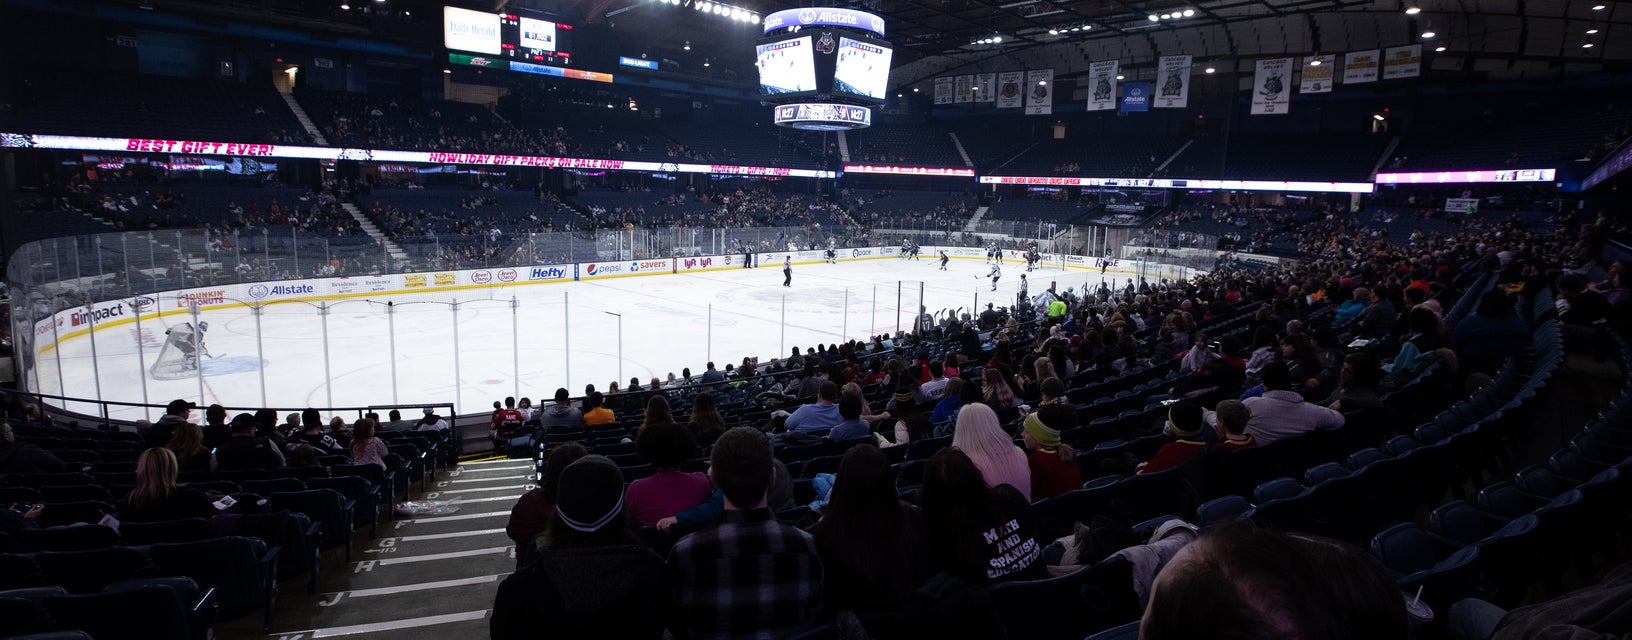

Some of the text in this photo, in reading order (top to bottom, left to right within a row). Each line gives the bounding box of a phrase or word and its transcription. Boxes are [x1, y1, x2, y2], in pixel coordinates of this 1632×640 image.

[817, 11, 859, 24] Allstate
[450, 20, 469, 32] Daily
[471, 24, 496, 37] Herald
[127, 138, 274, 156] BEST GIFT EVER!
[429, 152, 624, 169] HOWLIDAY GIFT PACKS ON SALE NOW!
[710, 164, 791, 176] TICKETS GIFTS MORE
[640, 261, 666, 269] savers
[684, 258, 696, 269] lyft
[700, 257, 712, 268] lyft
[532, 266, 565, 279] Hefty
[599, 265, 621, 275] pepsi
[270, 284, 313, 295] Allstate
[190, 297, 223, 306] DONUTS
[79, 304, 124, 325] impact
[320, 434, 333, 447] 19
[395, 520, 412, 529] F
[983, 519, 1020, 545] MATH
[379, 537, 396, 548] G
[997, 533, 1020, 553] AND
[989, 537, 1035, 568] SPANISH
[354, 560, 381, 573] H
[986, 543, 1040, 578] EDUCATION
[318, 591, 344, 607] J
